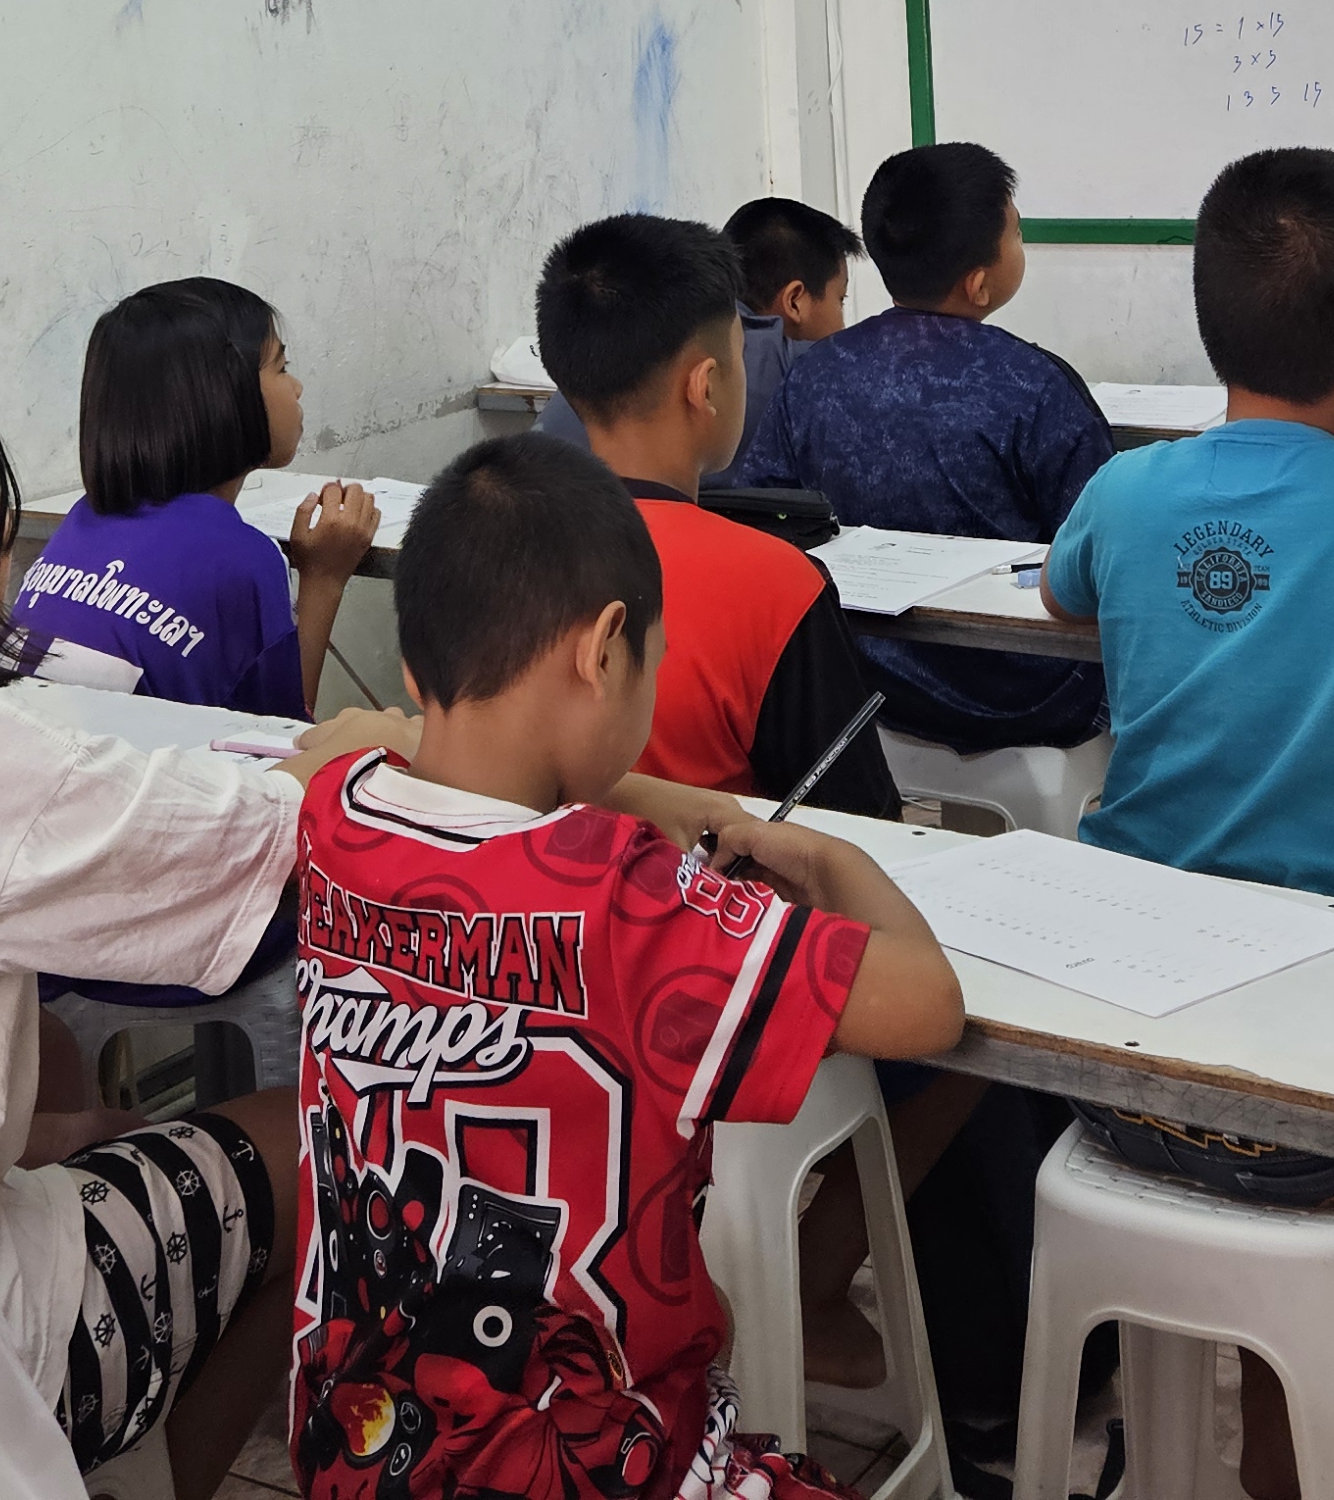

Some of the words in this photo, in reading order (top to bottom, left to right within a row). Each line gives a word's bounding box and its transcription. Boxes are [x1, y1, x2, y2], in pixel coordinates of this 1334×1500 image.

[1184, 23, 1204, 47] 15
[1174, 520, 1275, 558] LEGENDARY
[1197, 554, 1248, 583] CALIFORNIA
[1210, 571, 1233, 589] 89
[1181, 599, 1224, 633] ATHLETIC
[1226, 602, 1263, 633] DIVISION
[301, 860, 589, 1020] EAKERMAN
